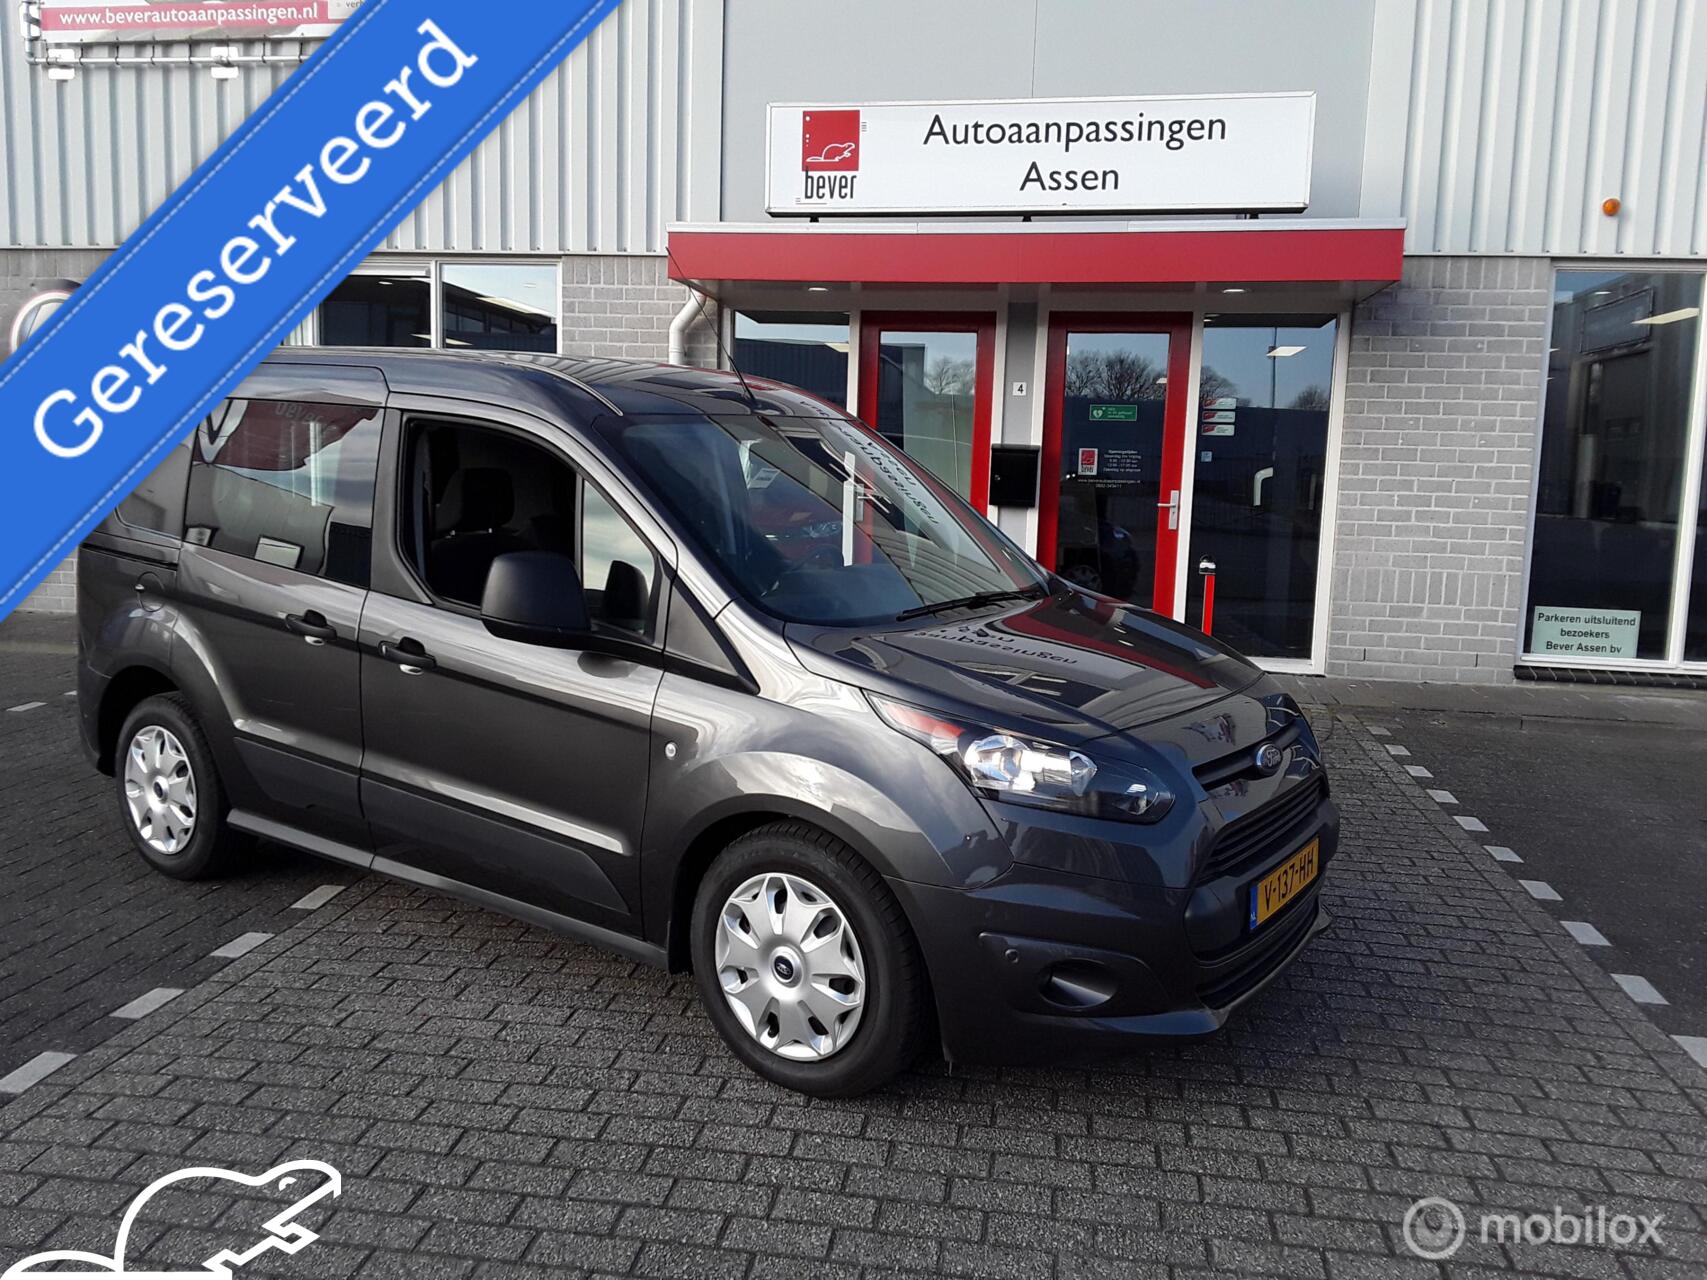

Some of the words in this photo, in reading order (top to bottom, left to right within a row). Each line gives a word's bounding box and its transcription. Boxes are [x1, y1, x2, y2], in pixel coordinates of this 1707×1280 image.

[60, 3, 318, 25] www.beverautoaanpassingen.nl
[923, 112, 1227, 152] Autoaanpassingen
[804, 166, 857, 199] bever
[1019, 161, 1120, 191] Assen
[1017, 384, 1024, 394] 4
[1537, 612, 1581, 623] Parkeren
[1584, 614, 1636, 626] uitsluitend
[1560, 628, 1610, 639] bezoekers
[1546, 641, 1574, 651] Bever
[1577, 642, 1607, 652] Assen
[1610, 644, 1622, 653] bv
[1264, 847, 1314, 912] V-137-HH
